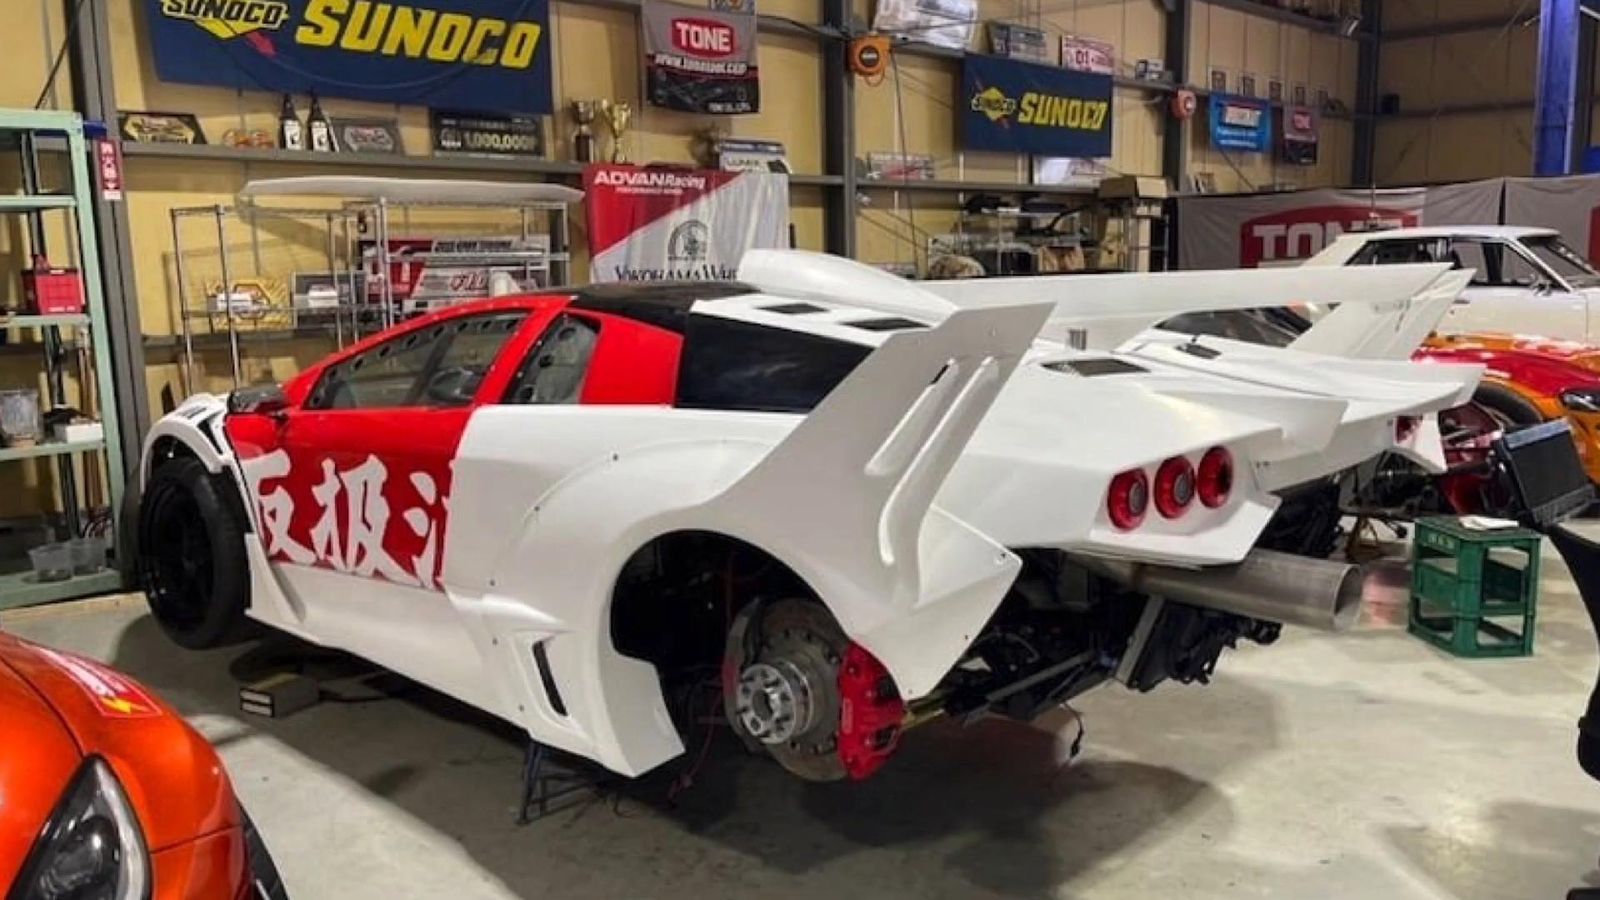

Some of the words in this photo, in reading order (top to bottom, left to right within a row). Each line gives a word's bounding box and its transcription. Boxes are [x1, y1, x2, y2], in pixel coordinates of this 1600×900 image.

[164, 0, 284, 25] SUNOCO
[295, 0, 541, 69] SUNOCO
[675, 22, 731, 52] TONE
[1018, 91, 1109, 130] SUNOCO
